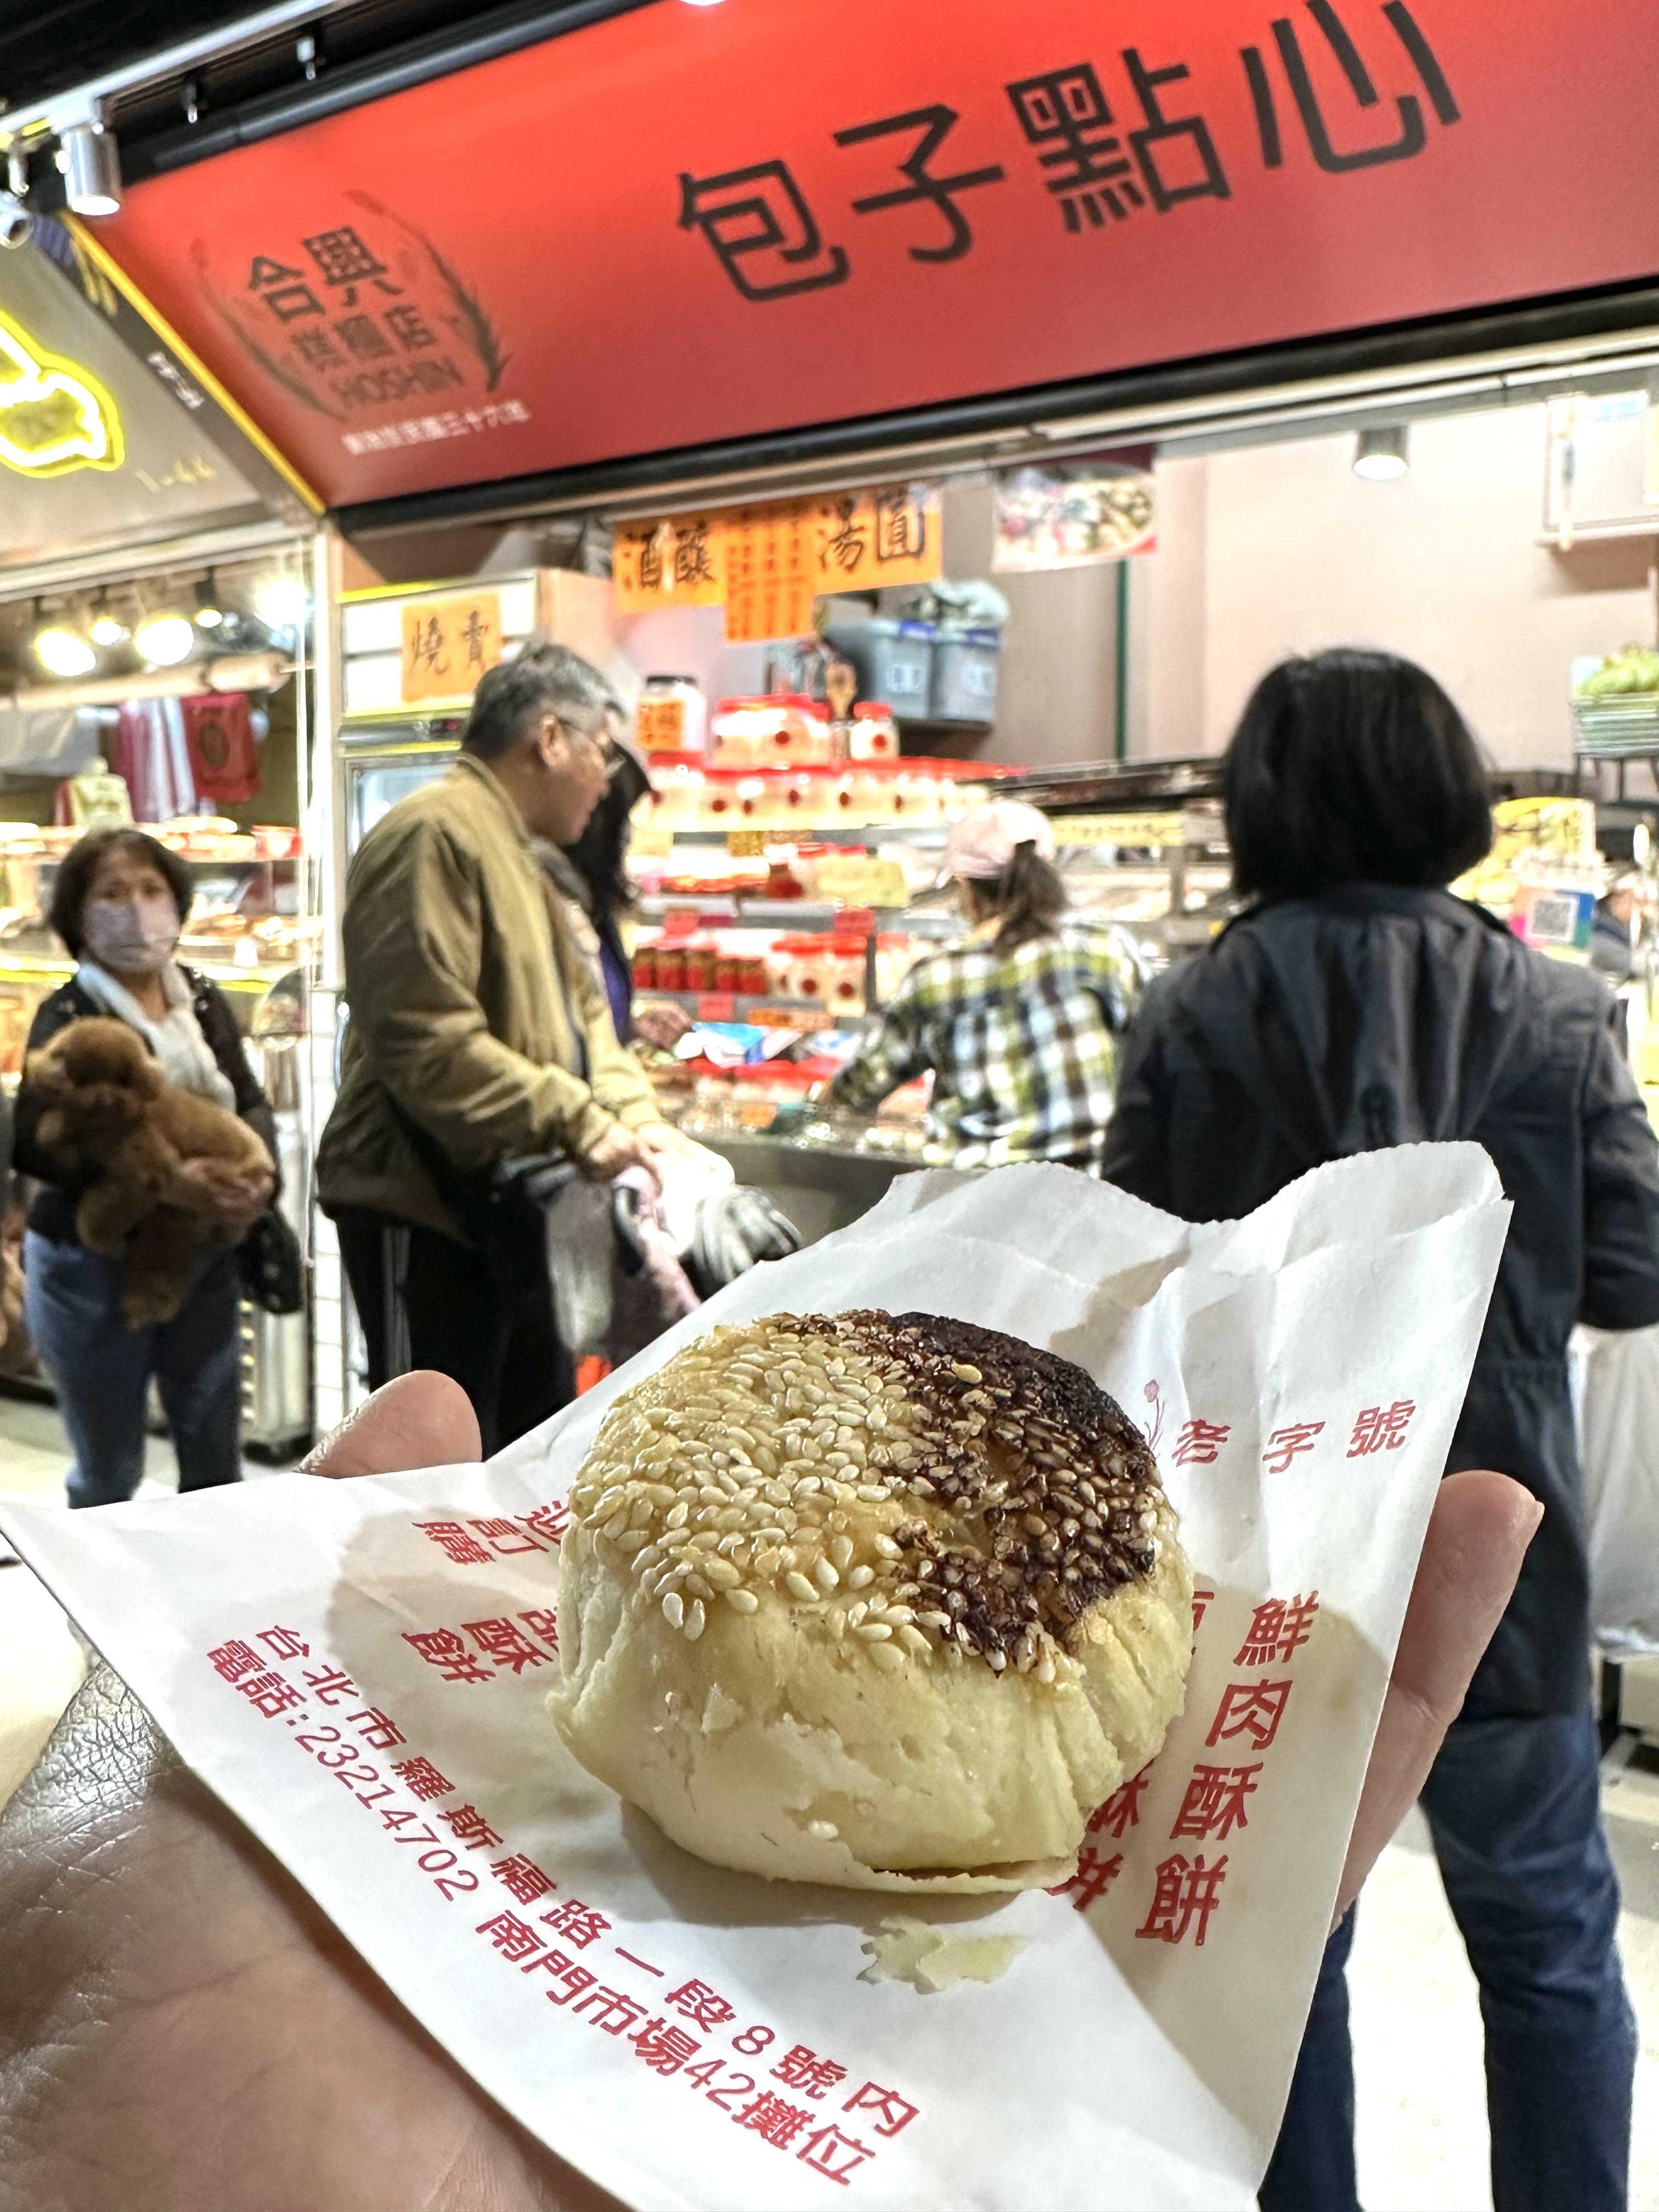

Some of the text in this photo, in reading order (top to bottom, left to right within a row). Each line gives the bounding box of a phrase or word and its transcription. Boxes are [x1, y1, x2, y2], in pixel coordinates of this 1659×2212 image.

[248, 225, 403, 325] 合興
[678, 0, 1461, 302] 包子點心
[1171, 1400, 1416, 1474] 老字號
[256, 1625, 919, 2138] 台北市羅斯福路一段8號內
[1135, 1590, 1319, 1946] 鮮肉酥餅
[476, 1910, 876, 2186] 南門市場42攤位
